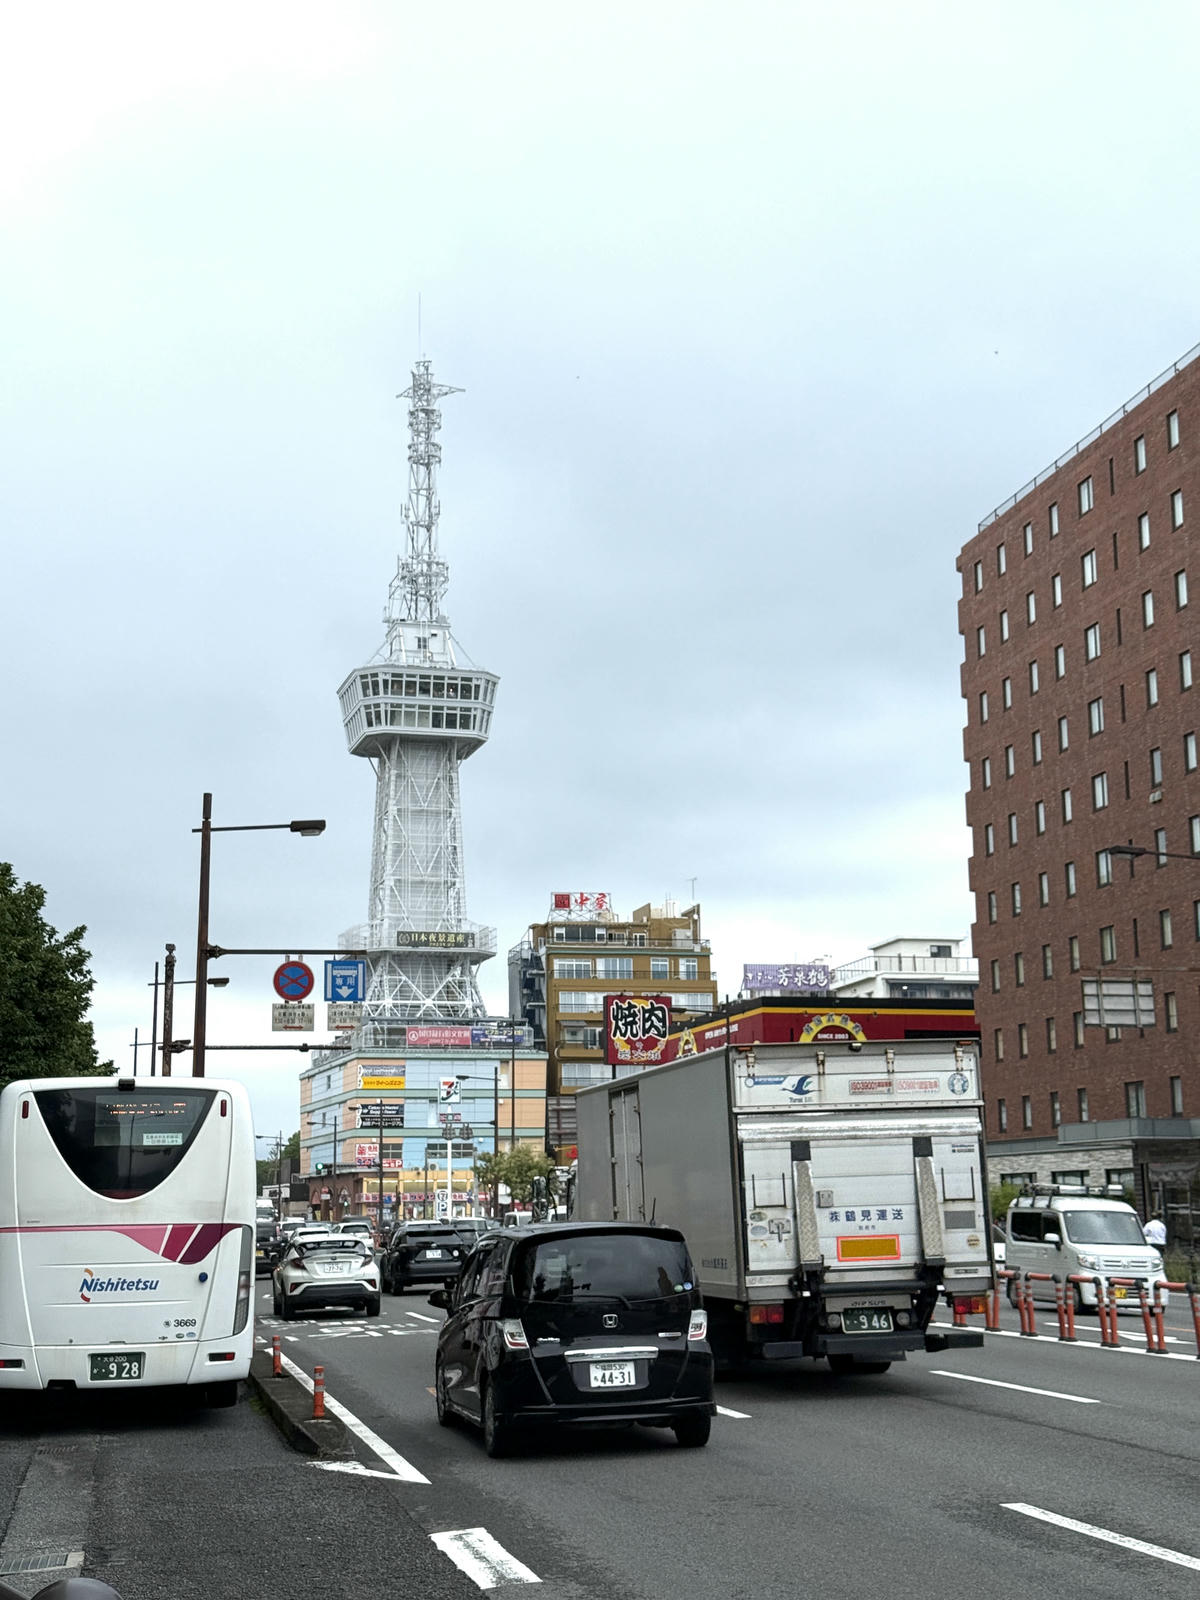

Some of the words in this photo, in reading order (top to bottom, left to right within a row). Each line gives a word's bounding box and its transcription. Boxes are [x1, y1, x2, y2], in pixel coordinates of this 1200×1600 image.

[611, 1000, 668, 1039] 焼肉
[79, 1277, 159, 1293] Nishitetsu
[173, 1319, 197, 1328] 3669
[600, 1371, 632, 1384] 44-31
